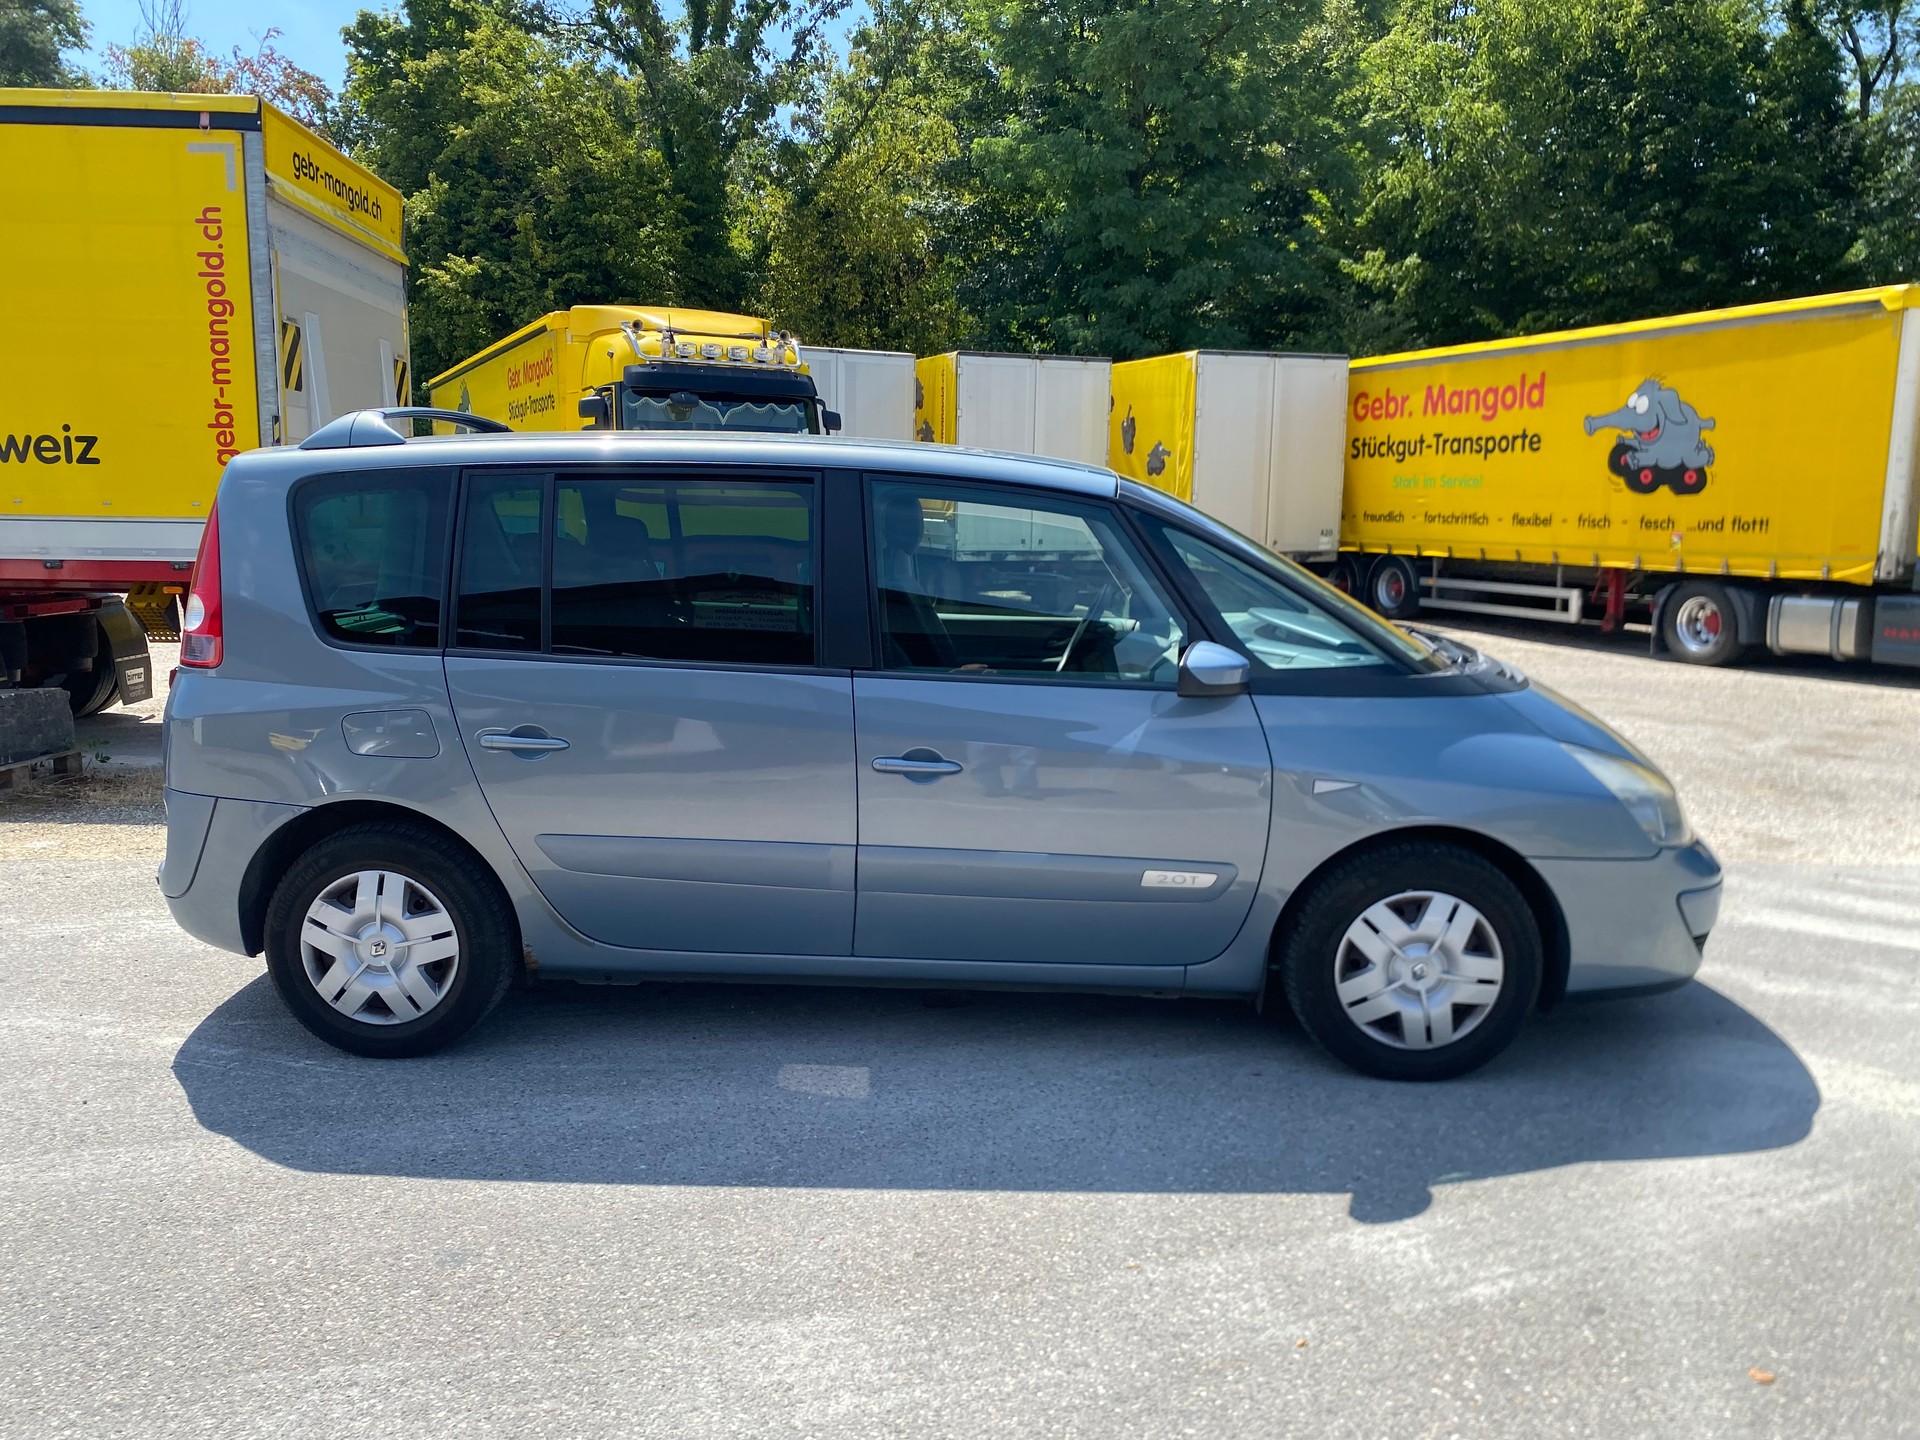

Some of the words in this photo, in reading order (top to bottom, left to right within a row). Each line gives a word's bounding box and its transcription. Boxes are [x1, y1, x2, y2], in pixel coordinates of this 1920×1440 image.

[292, 152, 382, 222] gebr-mangold.ch
[195, 206, 241, 467] gebr-mangold.ch
[1353, 387, 1413, 422] Gebr.
[1423, 371, 1546, 422] Mangold
[0, 424, 101, 464] weiz
[1351, 428, 1542, 463] Stückgut-Transporte
[1393, 475, 1419, 489] Stark
[1424, 475, 1436, 488] im
[1363, 510, 1405, 523] freundlich
[1424, 511, 1489, 526] fortschrittlich
[1512, 512, 1553, 527] flexibel
[1577, 513, 1611, 529] frisch
[1639, 514, 1675, 531] fesch
[1731, 516, 1770, 534] flott!
